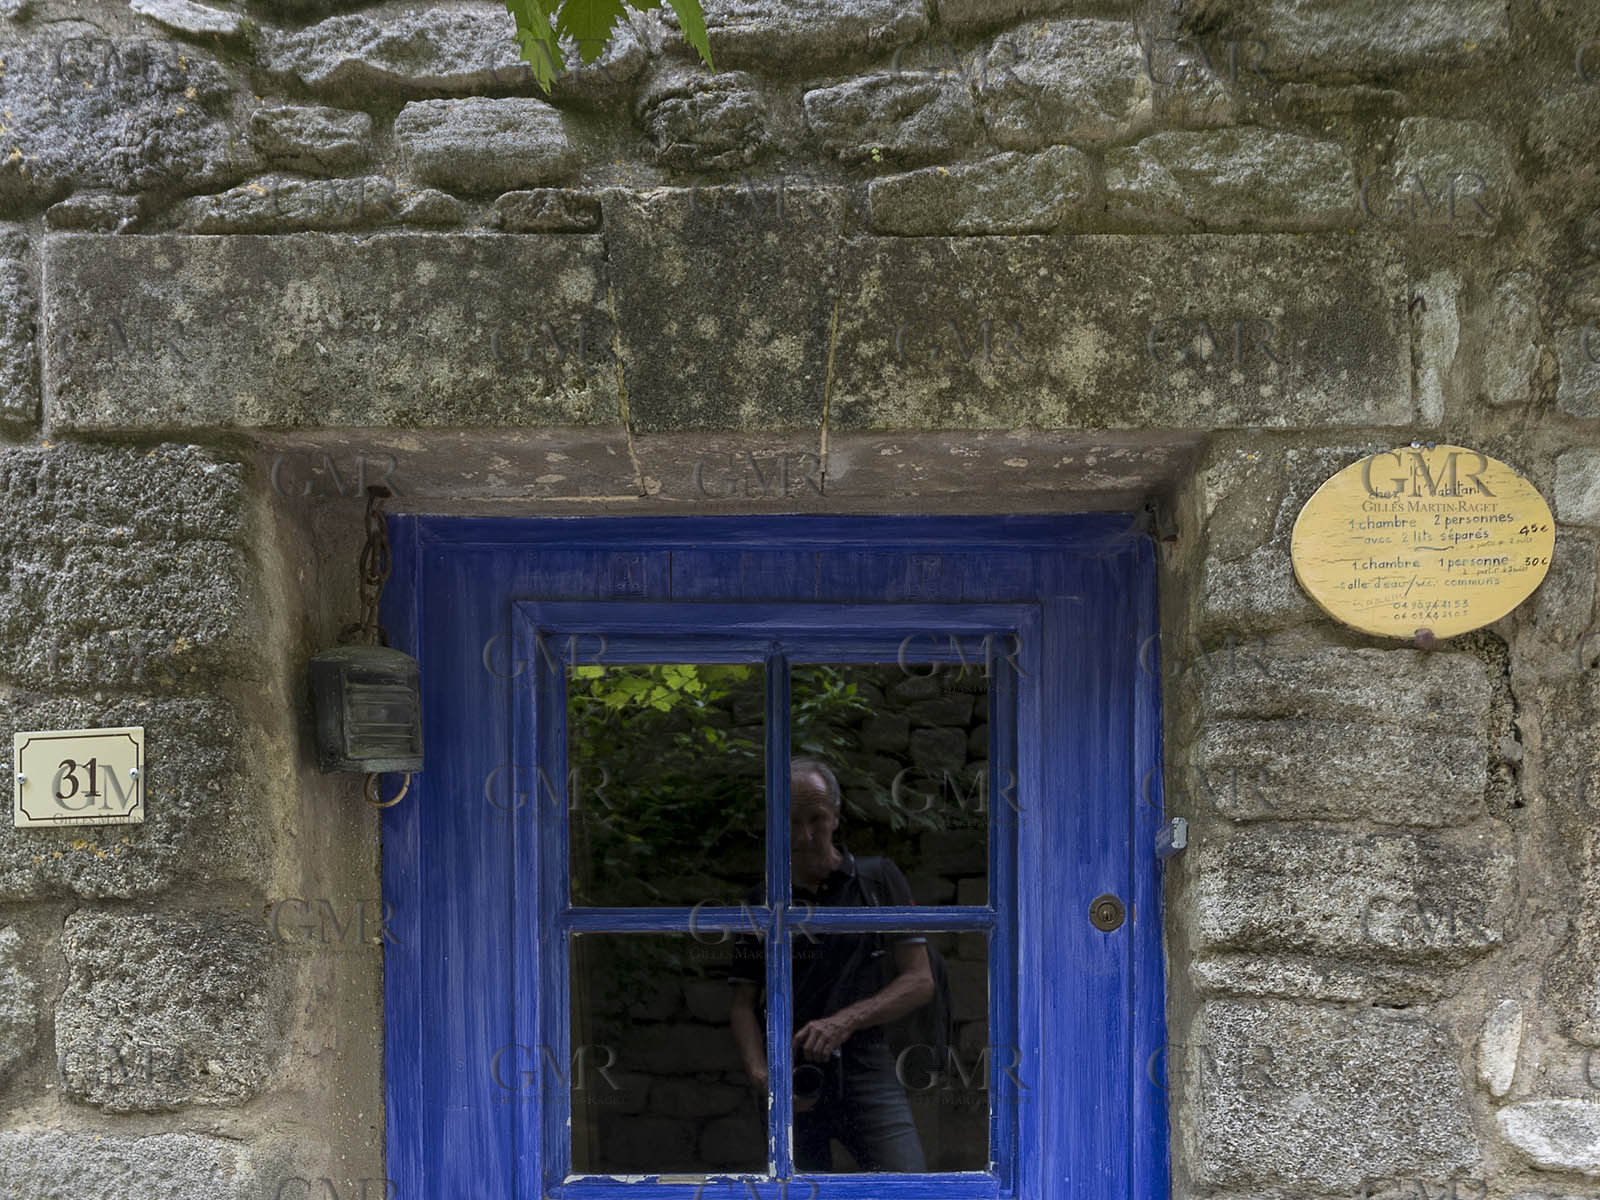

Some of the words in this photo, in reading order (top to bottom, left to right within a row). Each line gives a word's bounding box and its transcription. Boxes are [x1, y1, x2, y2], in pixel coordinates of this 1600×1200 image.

[1368, 486, 1400, 504] chez
[1349, 519, 1355, 529] 1
[1359, 514, 1417, 529] chambre
[1433, 514, 1441, 525] 2
[1444, 512, 1514, 530] personnes
[1414, 530, 1433, 541] lits
[1440, 528, 1490, 545] séparés
[1352, 561, 1358, 570] 1
[1362, 556, 1420, 570] chambre
[1439, 558, 1444, 568] 1
[1447, 555, 1509, 573] personne
[1340, 578, 1369, 590] salle
[1445, 579, 1500, 587] communs
[56, 758, 101, 799] 31
